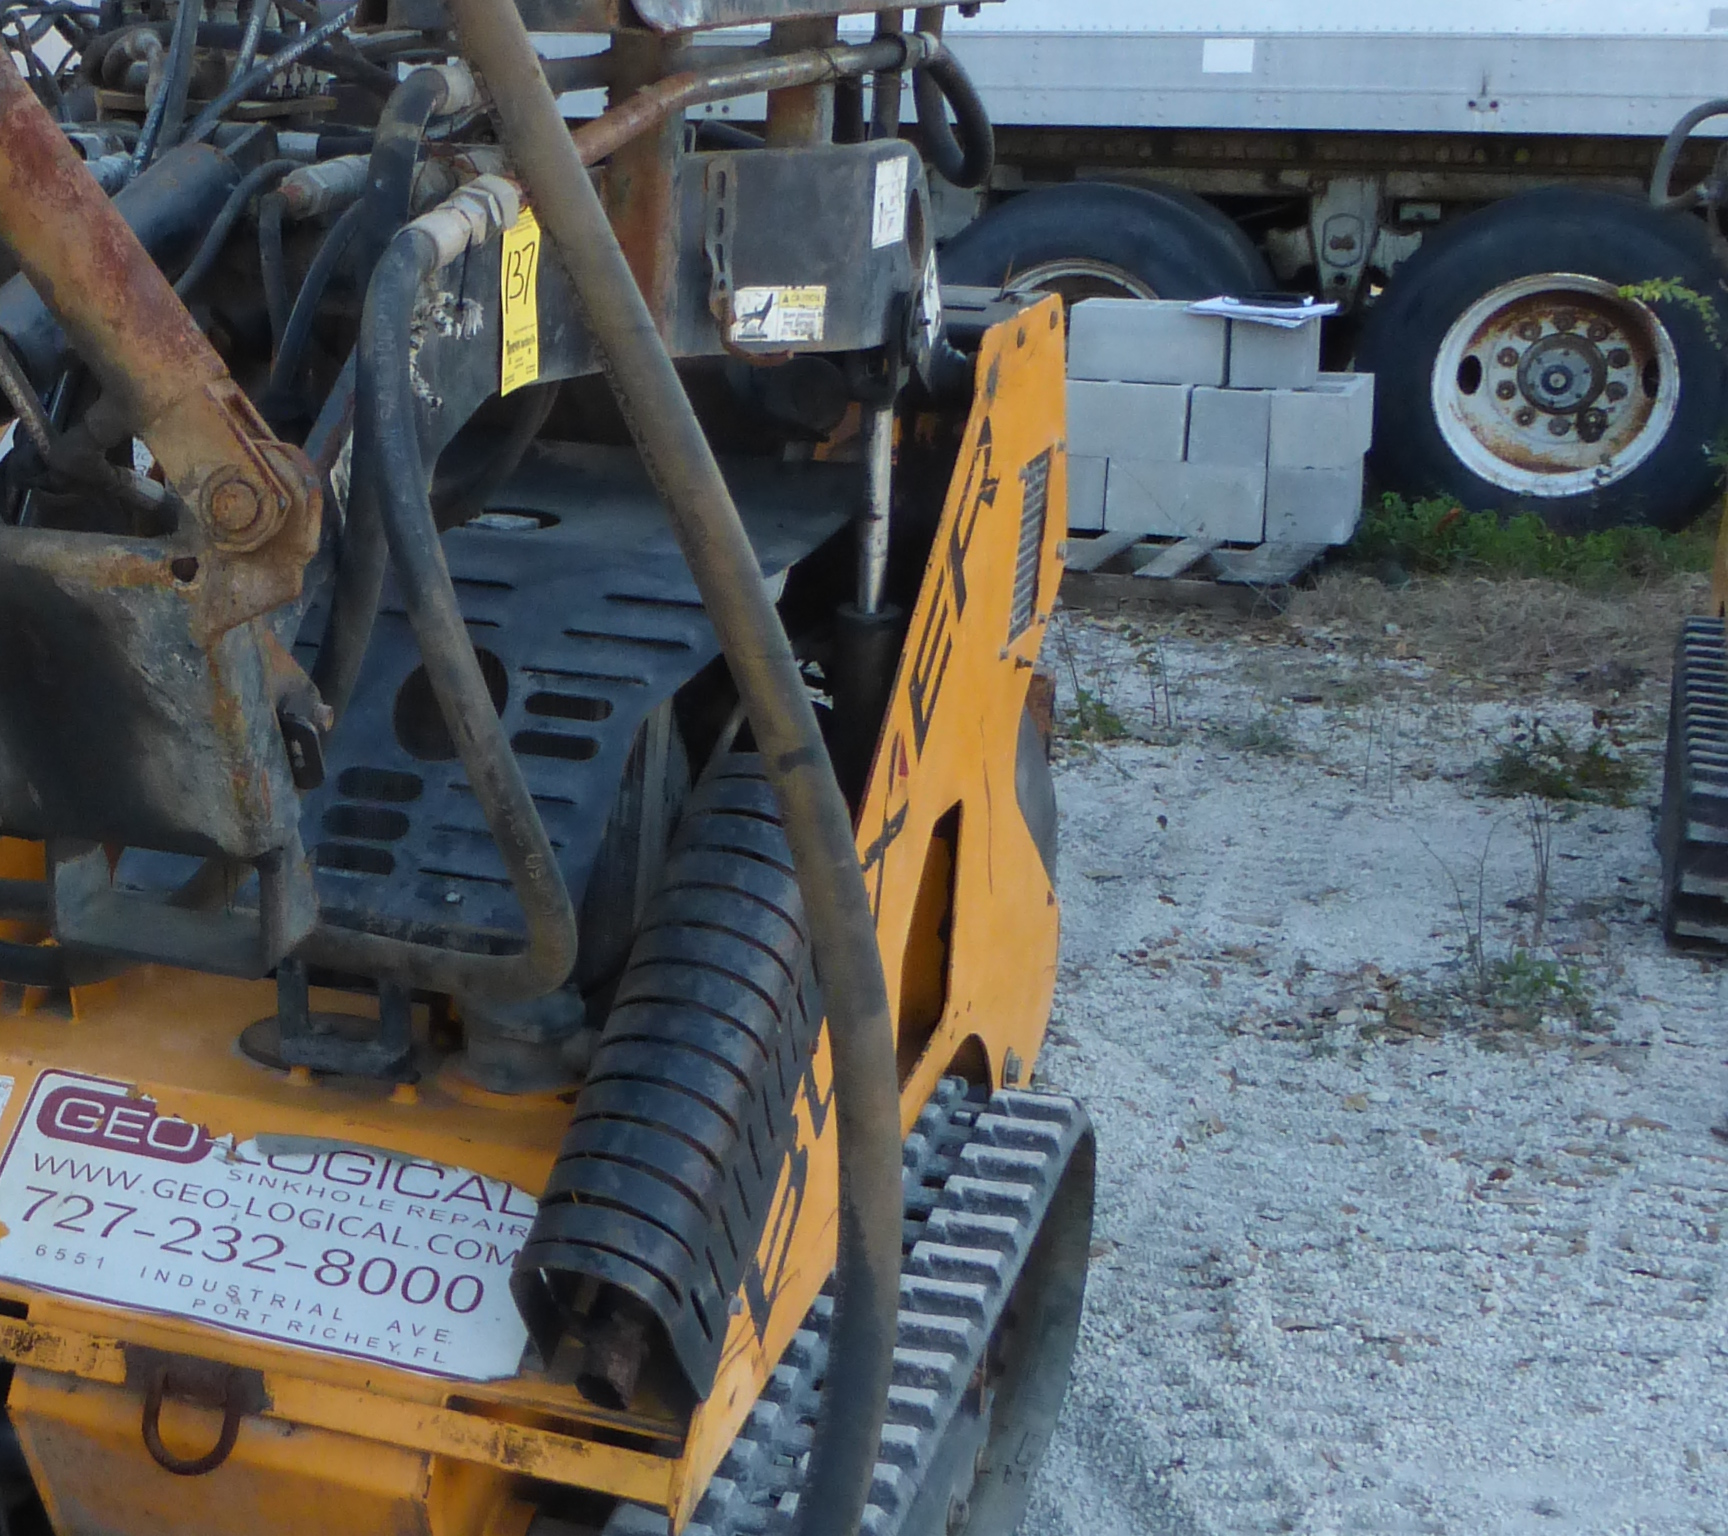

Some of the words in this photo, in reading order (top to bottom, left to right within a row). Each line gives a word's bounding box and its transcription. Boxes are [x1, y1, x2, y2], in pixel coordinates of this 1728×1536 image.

[505, 240, 536, 315] 137
[34, 1152, 521, 1268] WWW.GEO-LOGICAL.COM
[226, 1168, 395, 1212] SINKHOLE
[406, 1204, 530, 1239] REPAIR
[22, 1185, 484, 1314] 727-232-8000
[35, 1244, 105, 1269] 6551
[139, 1265, 343, 1321] INDUSTRIAL
[192, 1298, 271, 1325] PORT
[412, 1347, 446, 1364] FL
